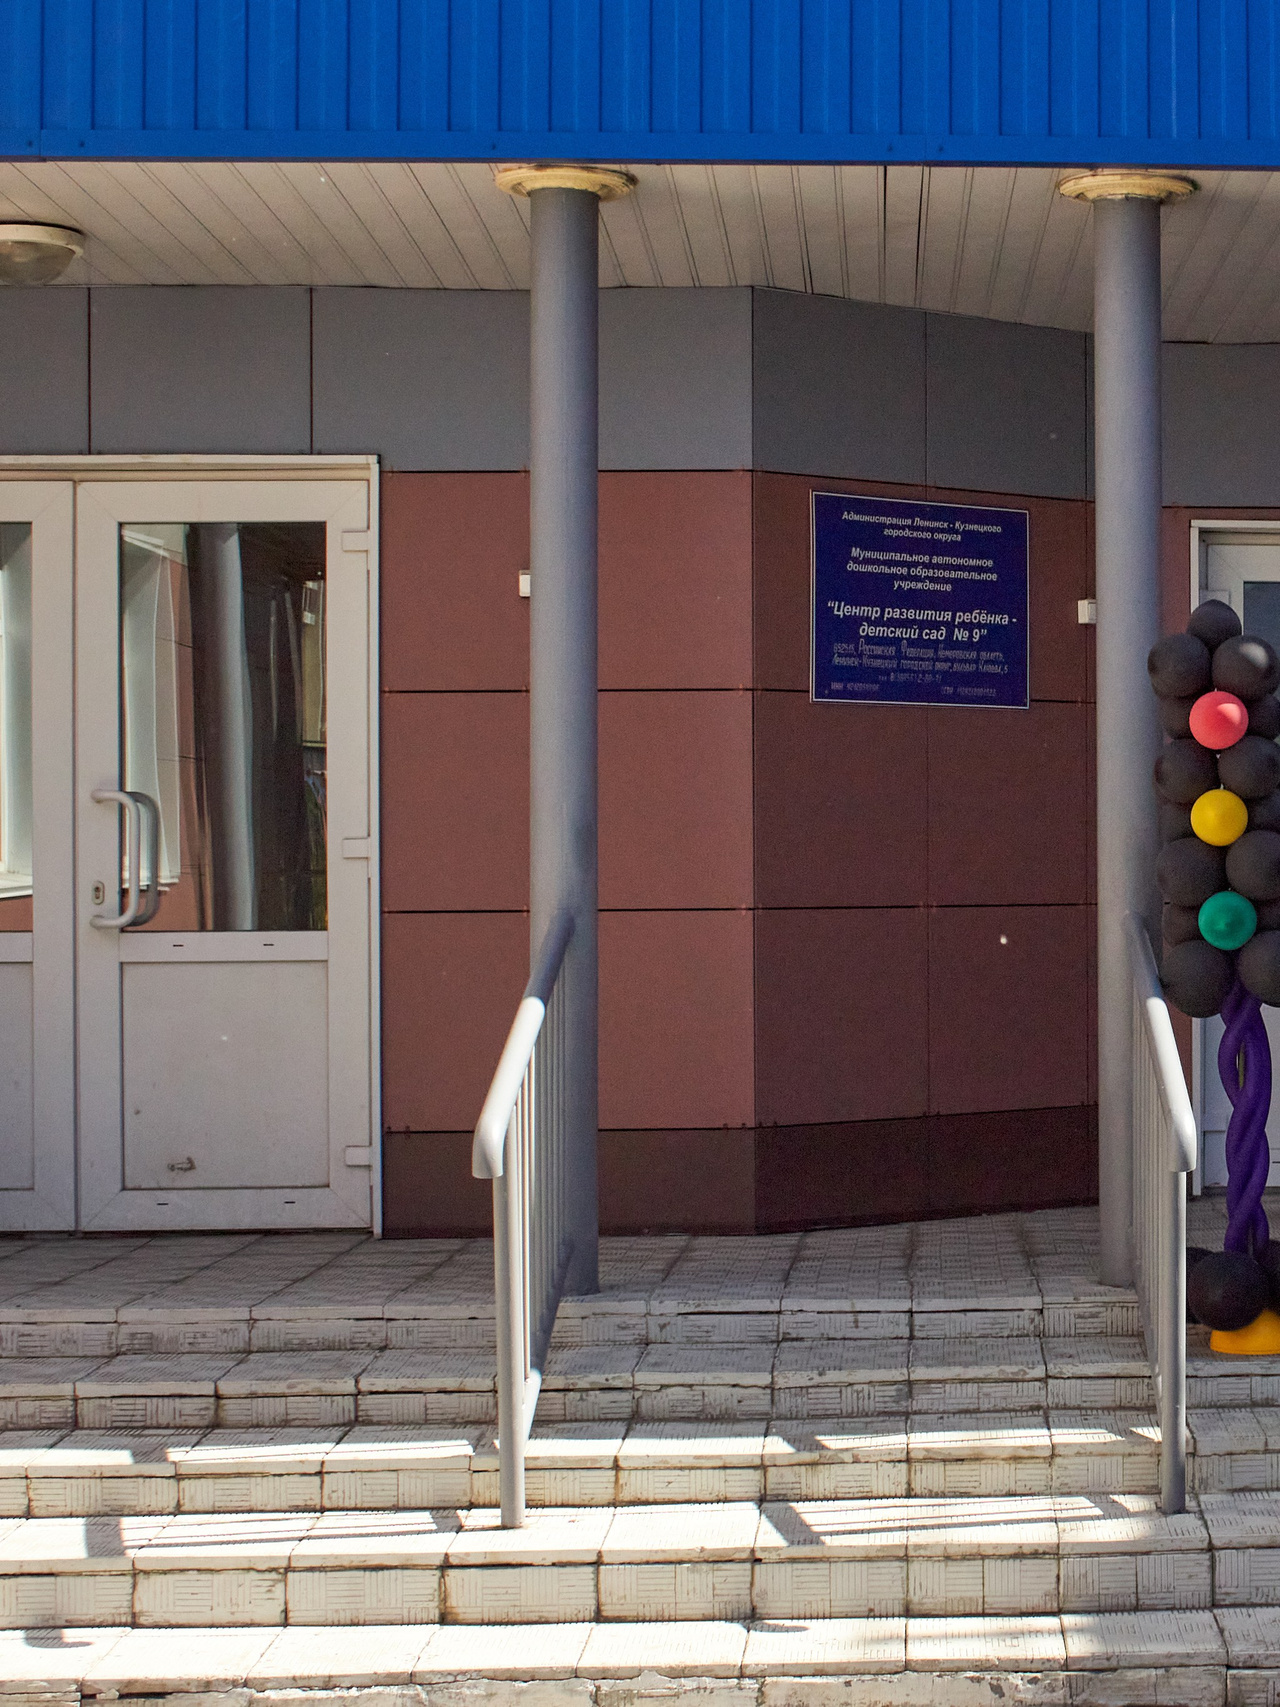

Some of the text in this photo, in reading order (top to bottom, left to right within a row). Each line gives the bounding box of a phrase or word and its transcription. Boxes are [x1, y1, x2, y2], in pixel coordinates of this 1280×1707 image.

[842, 511, 912, 525] Администрация
[914, 517, 948, 528] Ленинск
[955, 520, 1001, 533] Кузнецкого
[884, 528, 961, 542] городского округа
[851, 547, 993, 567] Муниципальное автономное
[847, 561, 997, 581] дошкольное образовательное
[893, 579, 952, 592] учреждение
[884, 608, 952, 622] развития
[955, 610, 1009, 625] ребёнка
[859, 622, 919, 639] детский
[922, 626, 946, 640] сад
[953, 628, 968, 641] №
